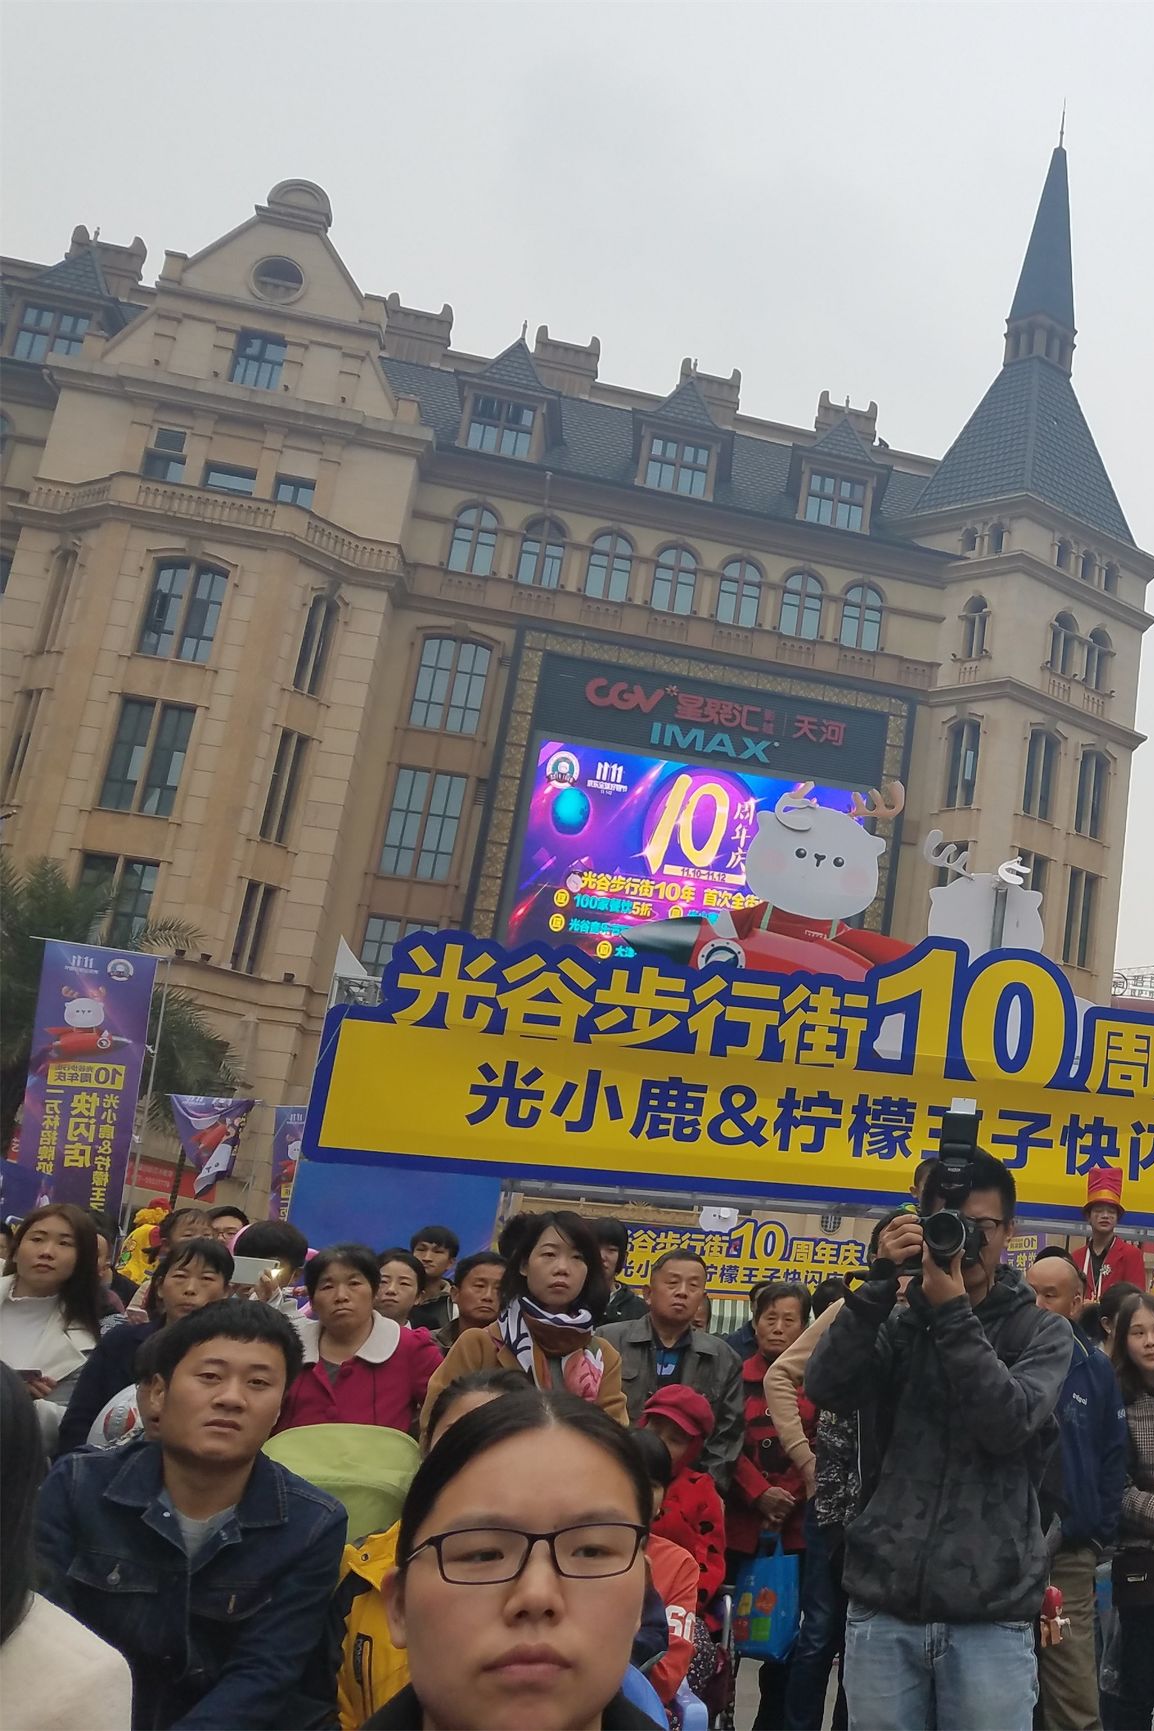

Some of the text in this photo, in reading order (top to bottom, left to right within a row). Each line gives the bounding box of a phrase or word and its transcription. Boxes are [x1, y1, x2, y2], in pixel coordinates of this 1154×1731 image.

[585, 677, 666, 713] CGV
[650, 722, 771, 764] IMAX
[792, 714, 847, 746] 天河
[645, 774, 730, 875] 10
[581, 870, 697, 904] 光谷步行街10年
[628, 1222, 866, 1267] 谷步行街10周年庆
